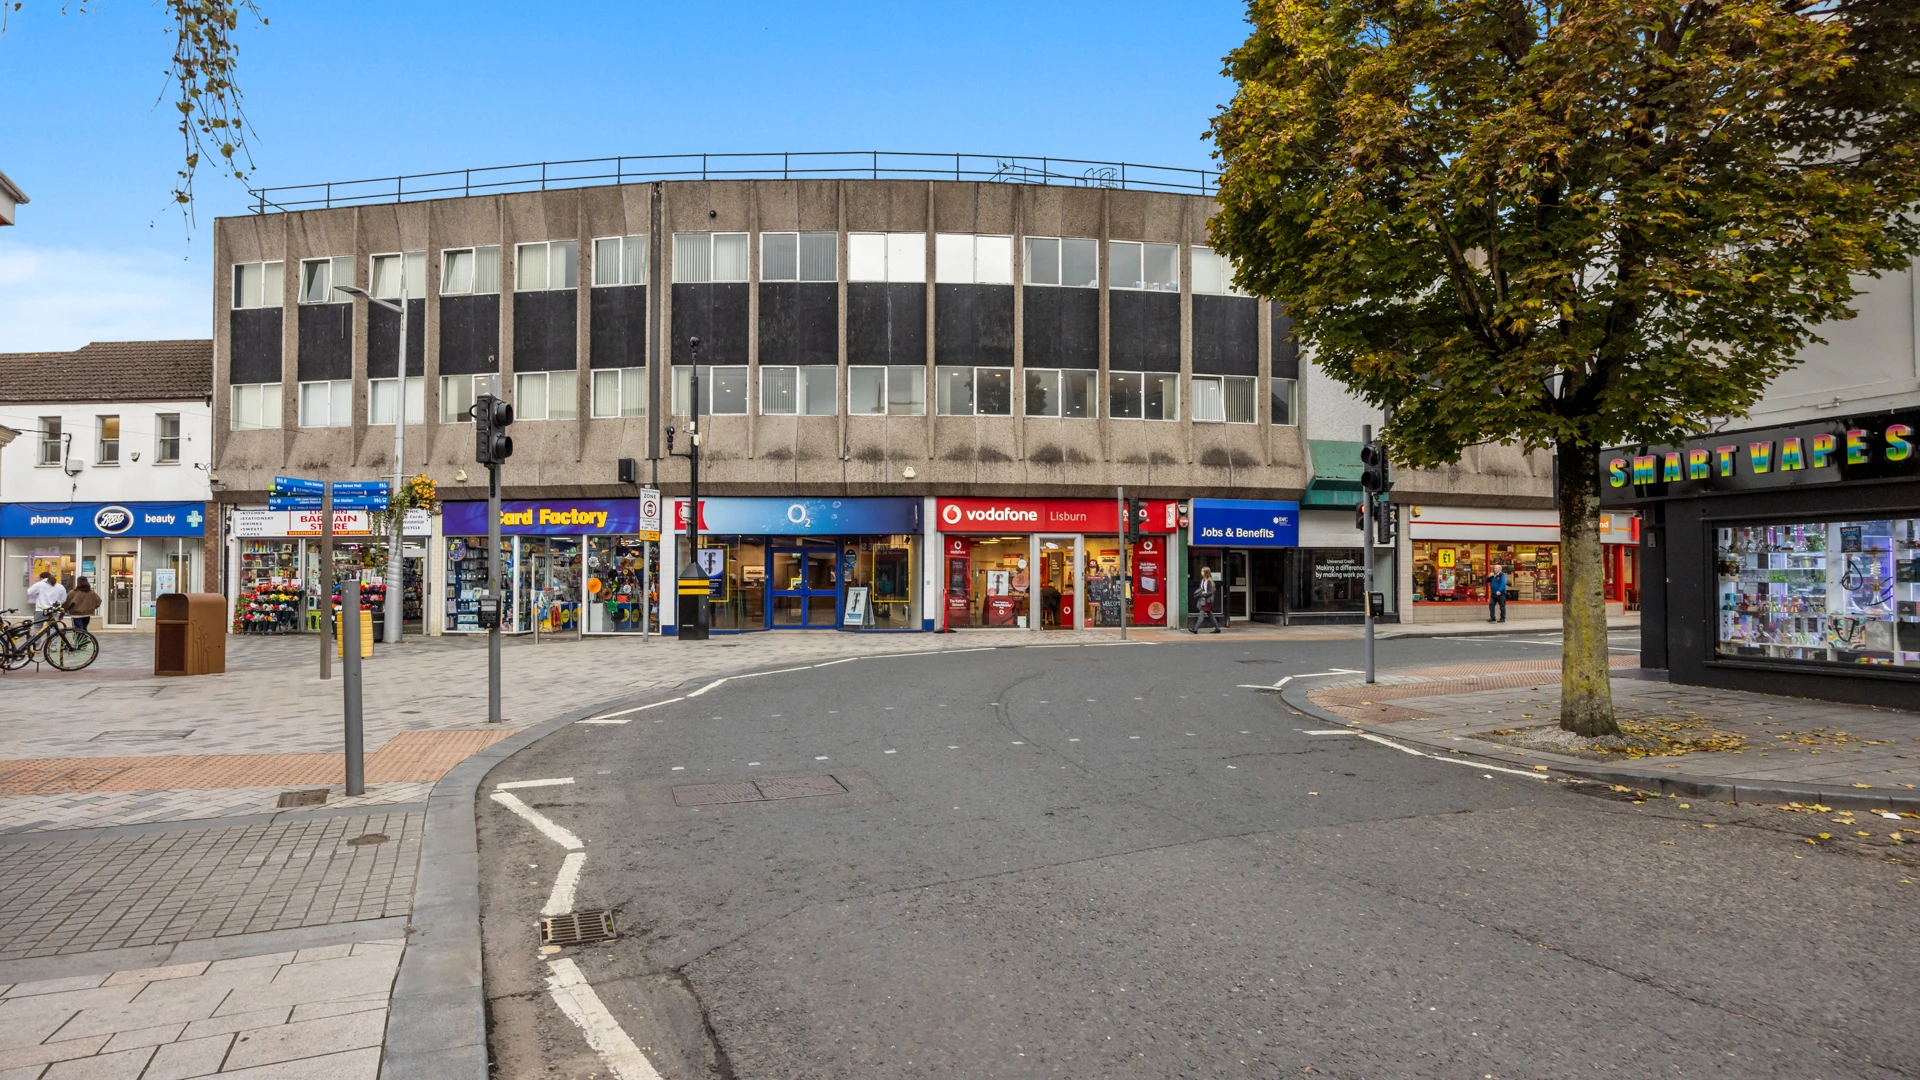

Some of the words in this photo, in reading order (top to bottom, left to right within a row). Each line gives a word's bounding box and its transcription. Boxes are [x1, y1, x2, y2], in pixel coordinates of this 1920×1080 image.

[1609, 444, 1739, 488] SMART
[1749, 423, 1913, 474] VAPES
[30, 514, 74, 526] pharmacy
[99, 512, 126, 527] Boots
[145, 513, 175, 525] beauty
[539, 508, 608, 528] Factory
[787, 503, 811, 528] O2
[966, 506, 1038, 522] vodafone
[1050, 511, 1087, 522] Lisburn
[1201, 527, 1223, 538] Jobs
[1225, 528, 1234, 537] &
[1236, 528, 1275, 539] Benefits
[1442, 553, 1451, 563] £1
[1316, 564, 1335, 573] Making
[1315, 572, 1322, 580] by
